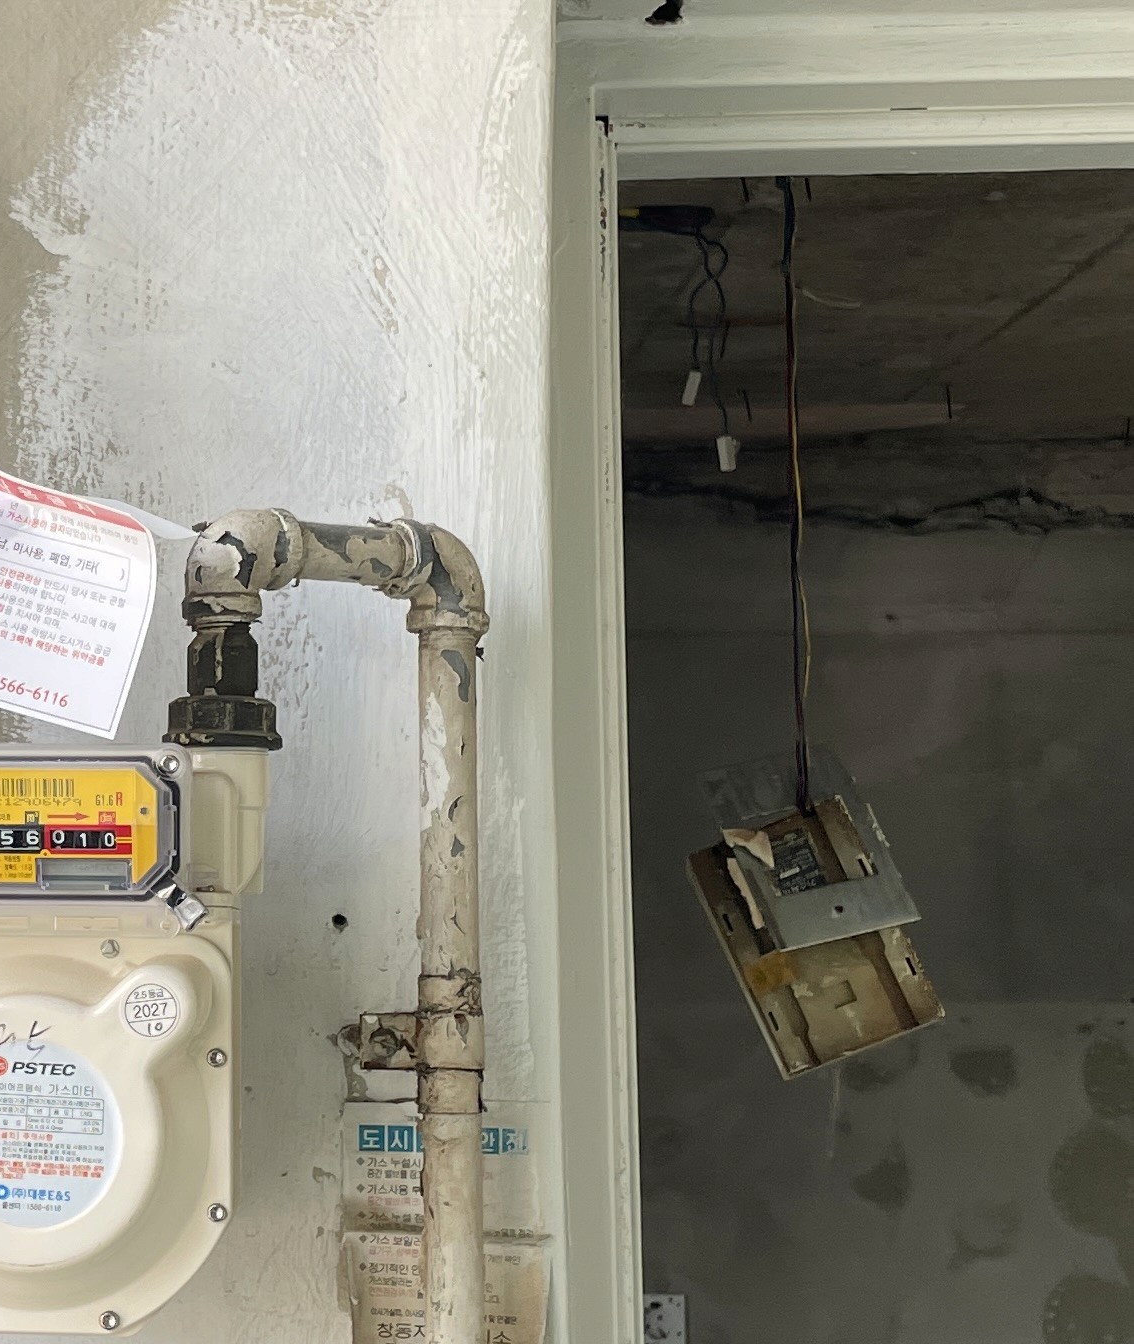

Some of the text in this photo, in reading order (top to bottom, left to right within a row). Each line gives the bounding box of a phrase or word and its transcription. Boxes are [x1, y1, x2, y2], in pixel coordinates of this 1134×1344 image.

[133, 1003, 168, 1019] 2027
[11, 1061, 77, 1077] PSTEC
[48, 1083, 94, 1097] 가스미터
[367, 1157, 388, 1168] 가스
[369, 1234, 390, 1245] 가스
[368, 1262, 409, 1275] 정기적인
